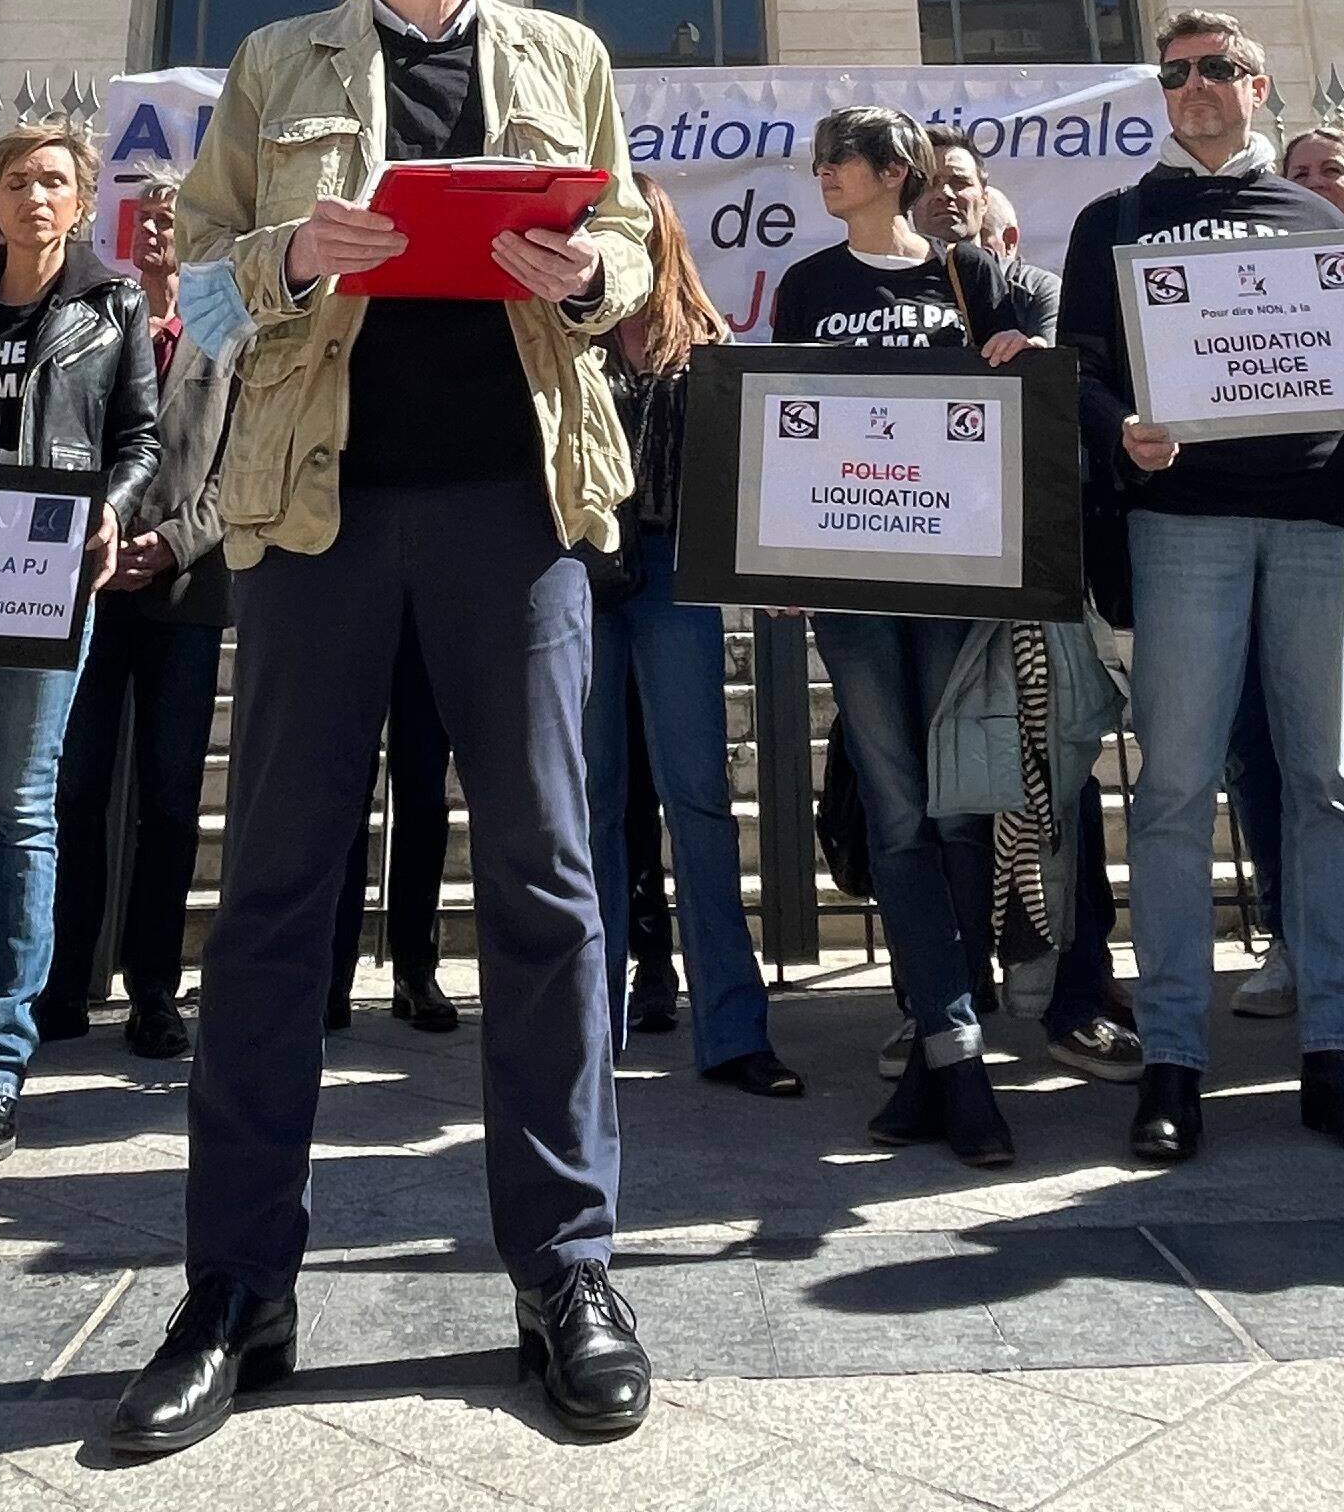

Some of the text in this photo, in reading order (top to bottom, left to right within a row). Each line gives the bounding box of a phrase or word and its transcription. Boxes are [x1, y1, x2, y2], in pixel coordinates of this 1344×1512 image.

[710, 188, 796, 249] de
[1200, 307, 1230, 319] Pour
[1232, 305, 1254, 316] dire
[1299, 302, 1311, 313] la
[1194, 330, 1332, 356] LIQUIDATION
[1227, 356, 1309, 377] POLICE
[1210, 378, 1334, 403] JUDICIAIRE
[841, 462, 921, 482] POLICE
[818, 512, 942, 535] JUDICIAIRE
[22, 558, 48, 576] PJ
